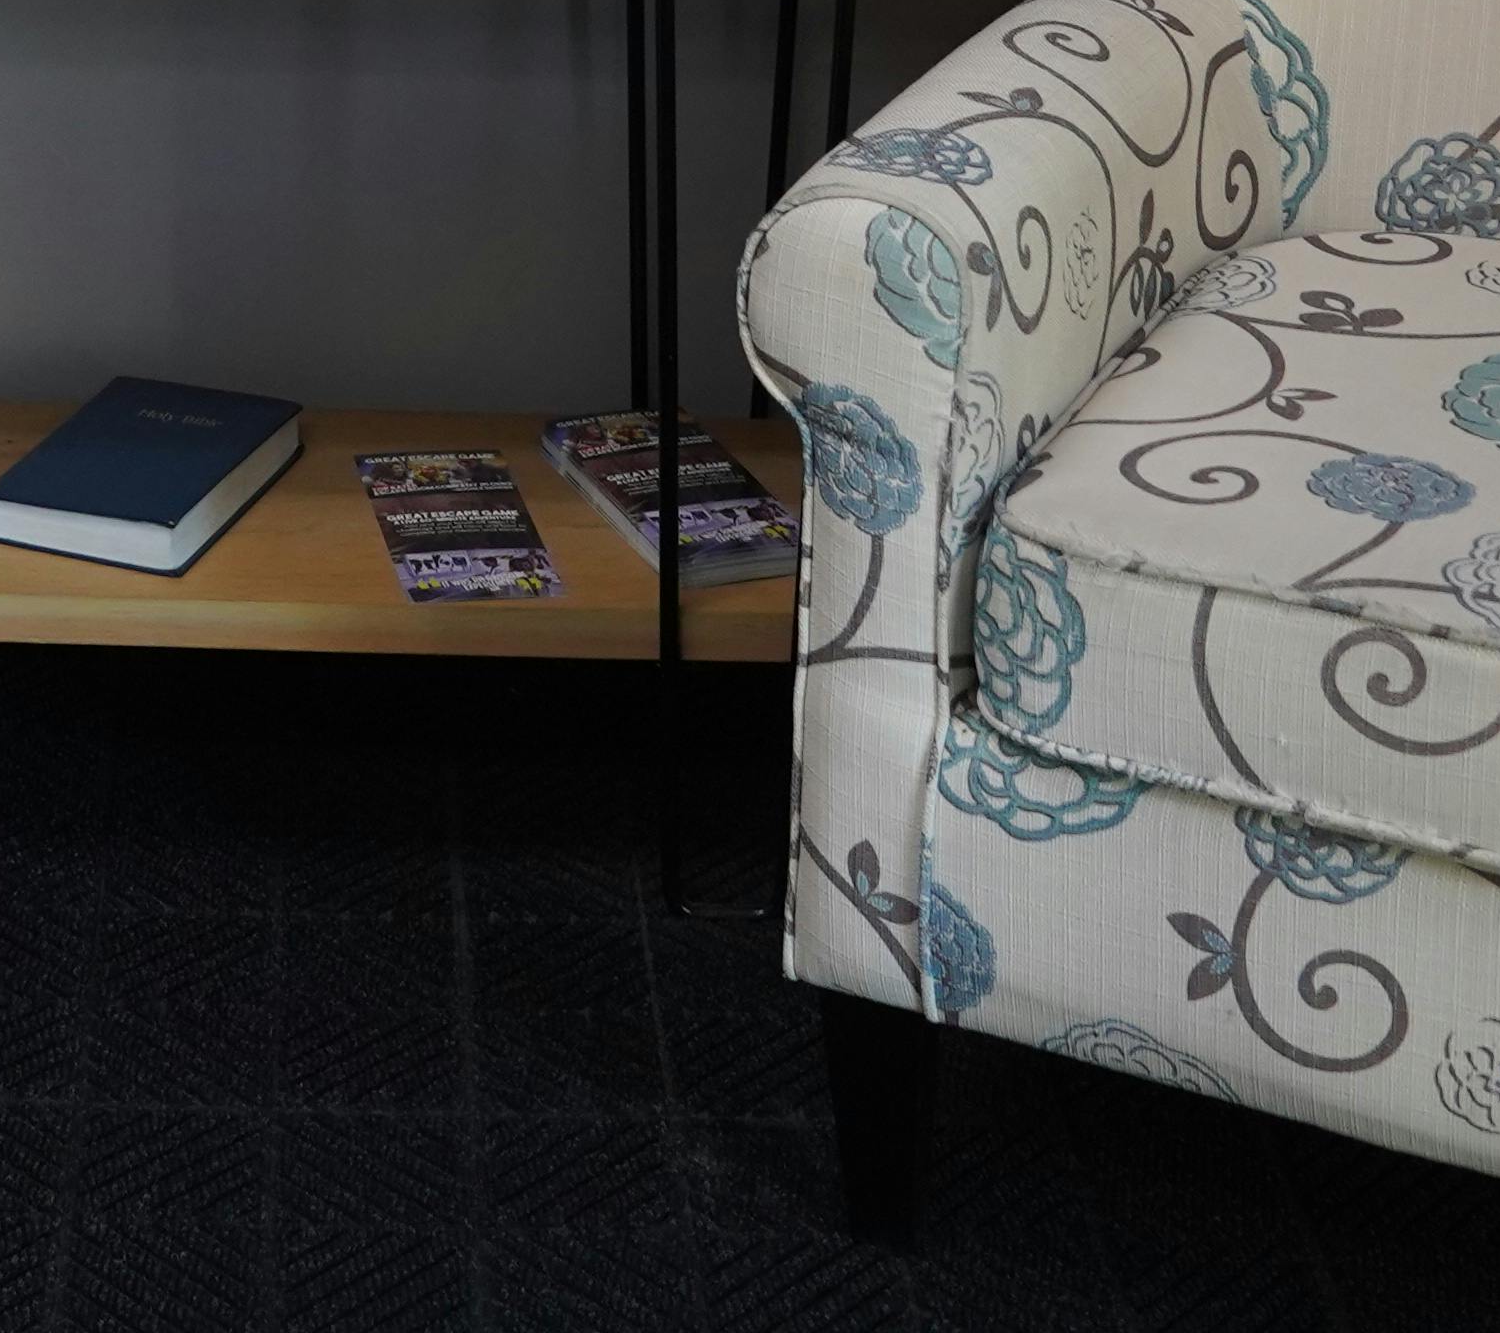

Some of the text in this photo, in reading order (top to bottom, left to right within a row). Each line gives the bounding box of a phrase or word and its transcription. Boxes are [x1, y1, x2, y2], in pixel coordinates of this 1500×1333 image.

[556, 411, 643, 428] GREAT ESCAPE
[364, 452, 497, 464] GREAT ESCAPE GAME
[606, 471, 645, 483] GREAT
[386, 509, 520, 523] GREAT ESCAPE GAME
